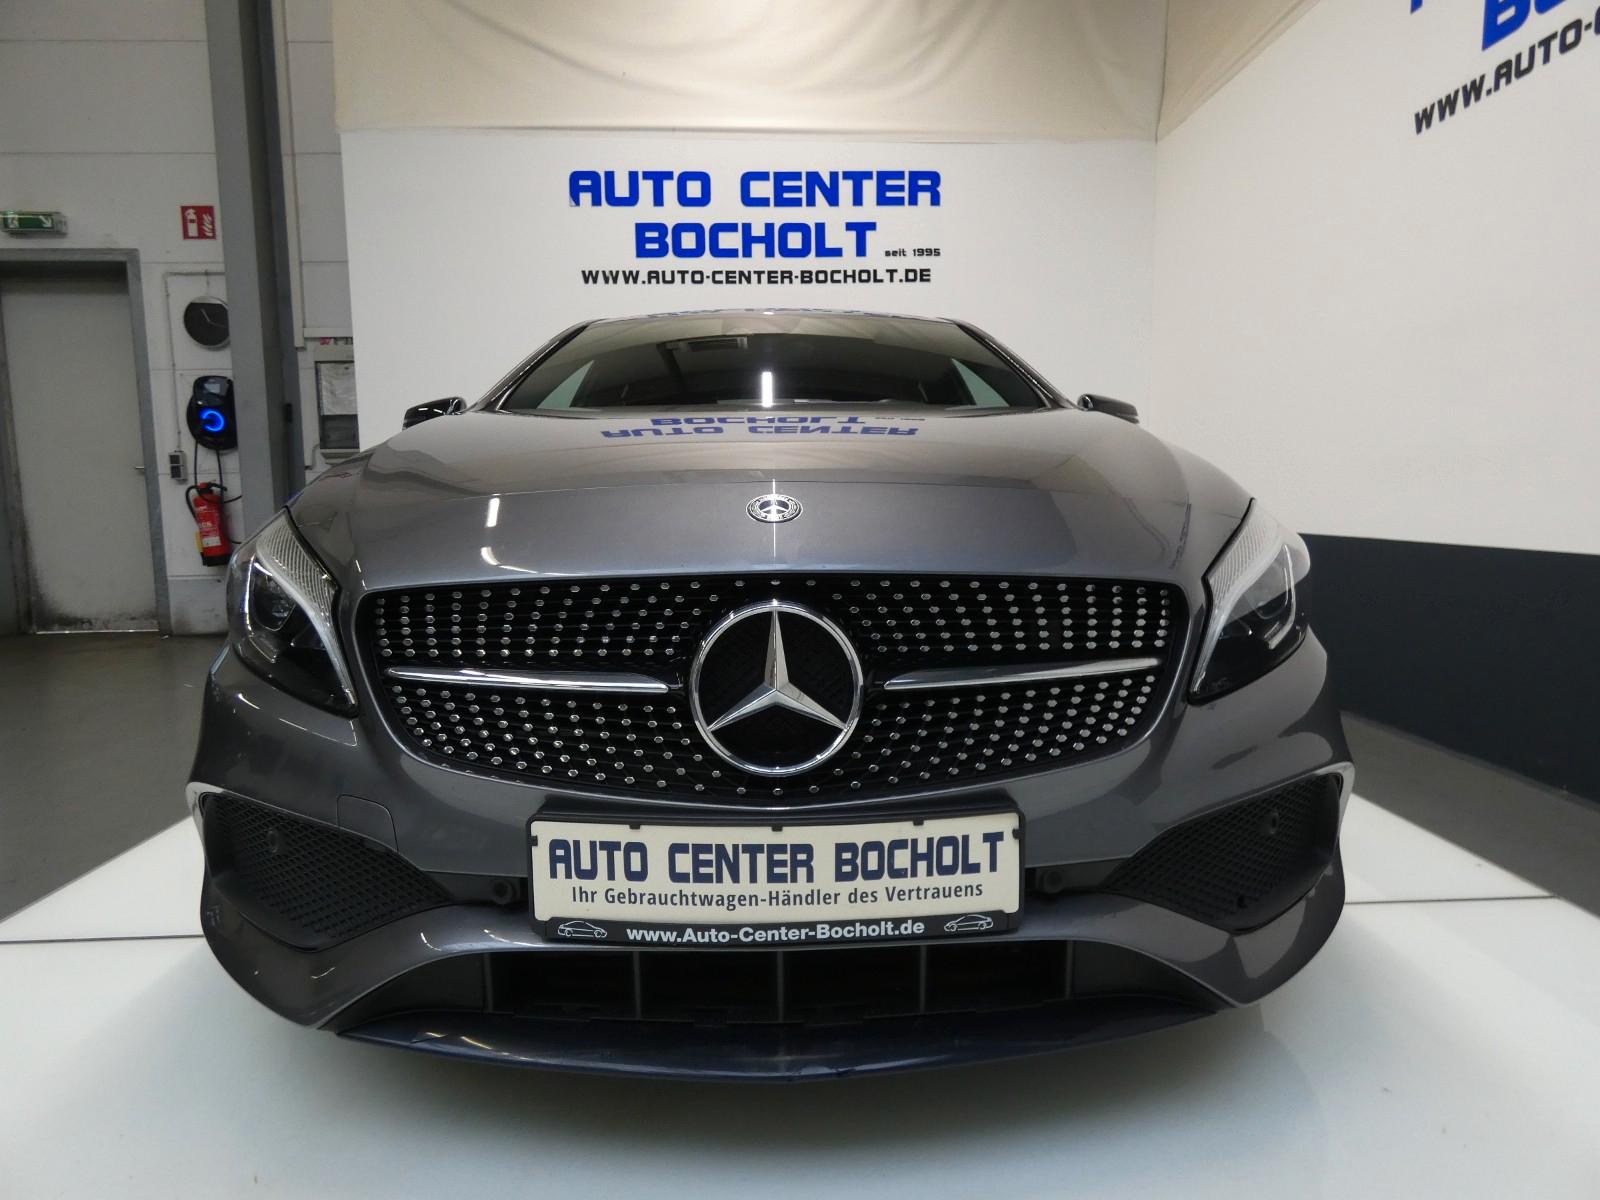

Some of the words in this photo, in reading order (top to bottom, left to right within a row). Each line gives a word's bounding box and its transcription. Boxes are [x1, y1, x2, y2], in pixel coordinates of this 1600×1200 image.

[568, 169, 712, 208] AUTO
[739, 169, 942, 208] CENTER
[634, 221, 877, 259] BOCHOLT
[884, 248, 907, 257] seit
[912, 247, 941, 257] 1995
[581, 268, 931, 285] WWW.AUTO-CENTER-BOCHOLT.DE
[548, 838, 648, 883] AUTO
[668, 842, 815, 885] CENTER
[834, 831, 1005, 883] BOCHOLT
[572, 886, 598, 904] Ihr
[604, 887, 841, 911] Gebrauchtwagen-Händler
[847, 887, 878, 904] des
[885, 883, 984, 902] Vertrauens
[626, 919, 925, 943] www.Auto-Center-Bocholt.de
